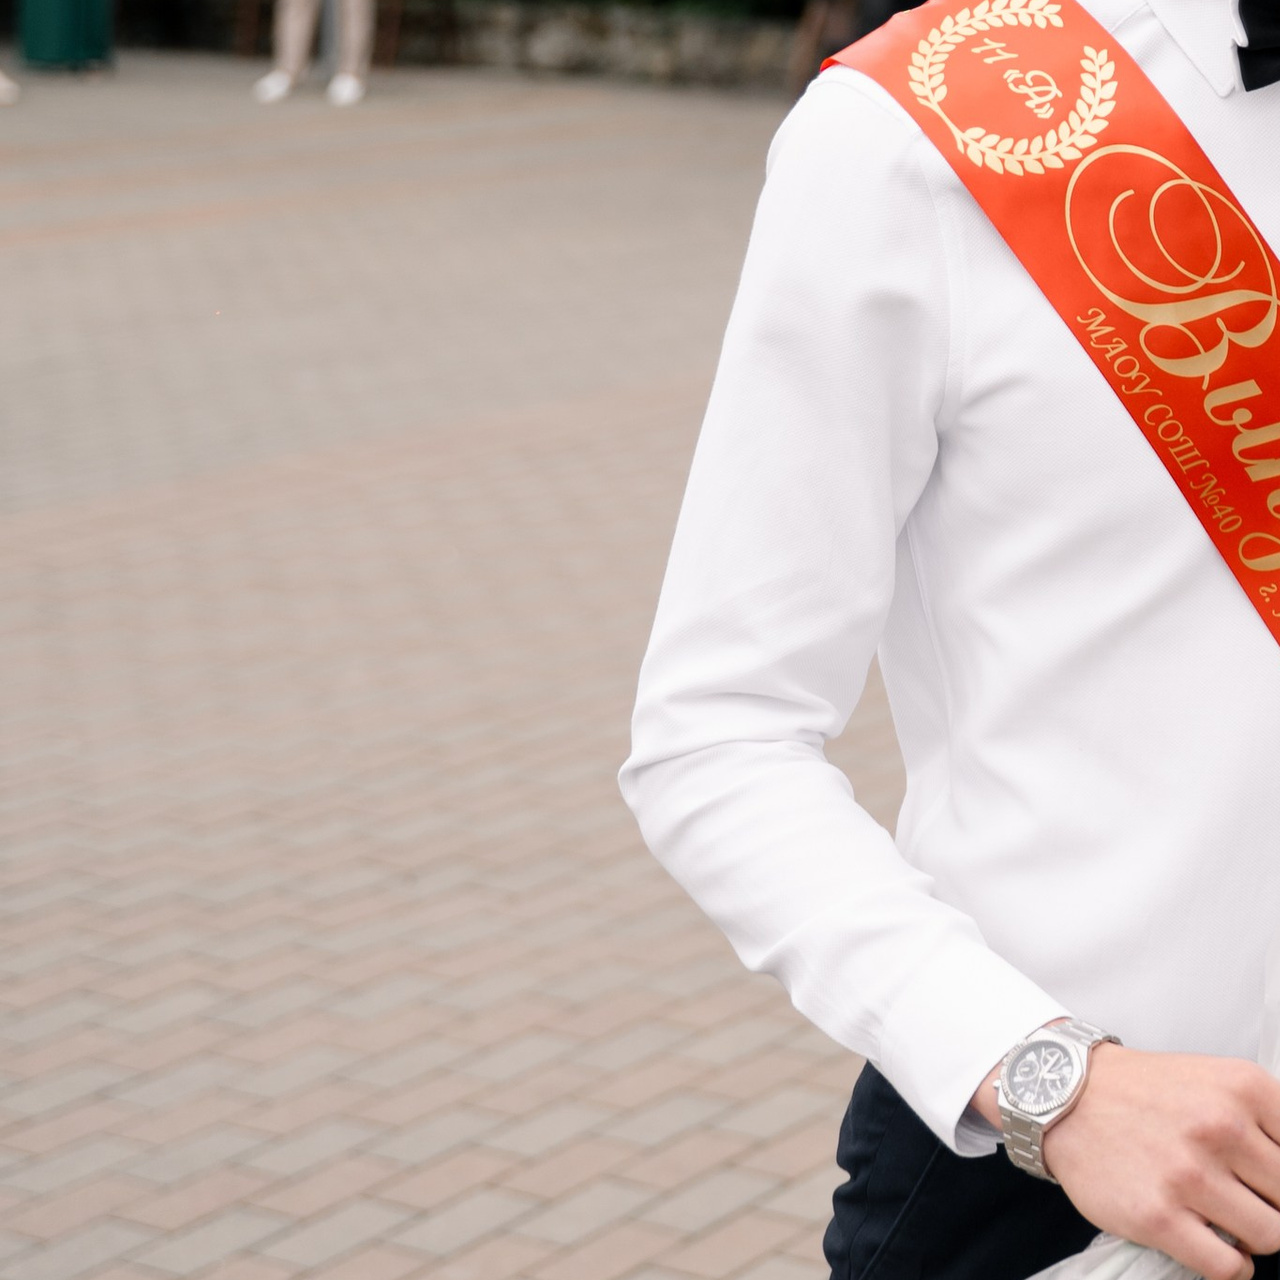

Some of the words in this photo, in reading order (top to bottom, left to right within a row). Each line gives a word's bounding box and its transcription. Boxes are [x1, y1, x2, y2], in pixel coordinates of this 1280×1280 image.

[970, 37, 1019, 64] 11
[1076, 307, 1163, 397] МАОУ
[1143, 403, 1210, 475] СОШ
[1189, 472, 1243, 534] №40
[1259, 583, 1278, 603] г.
